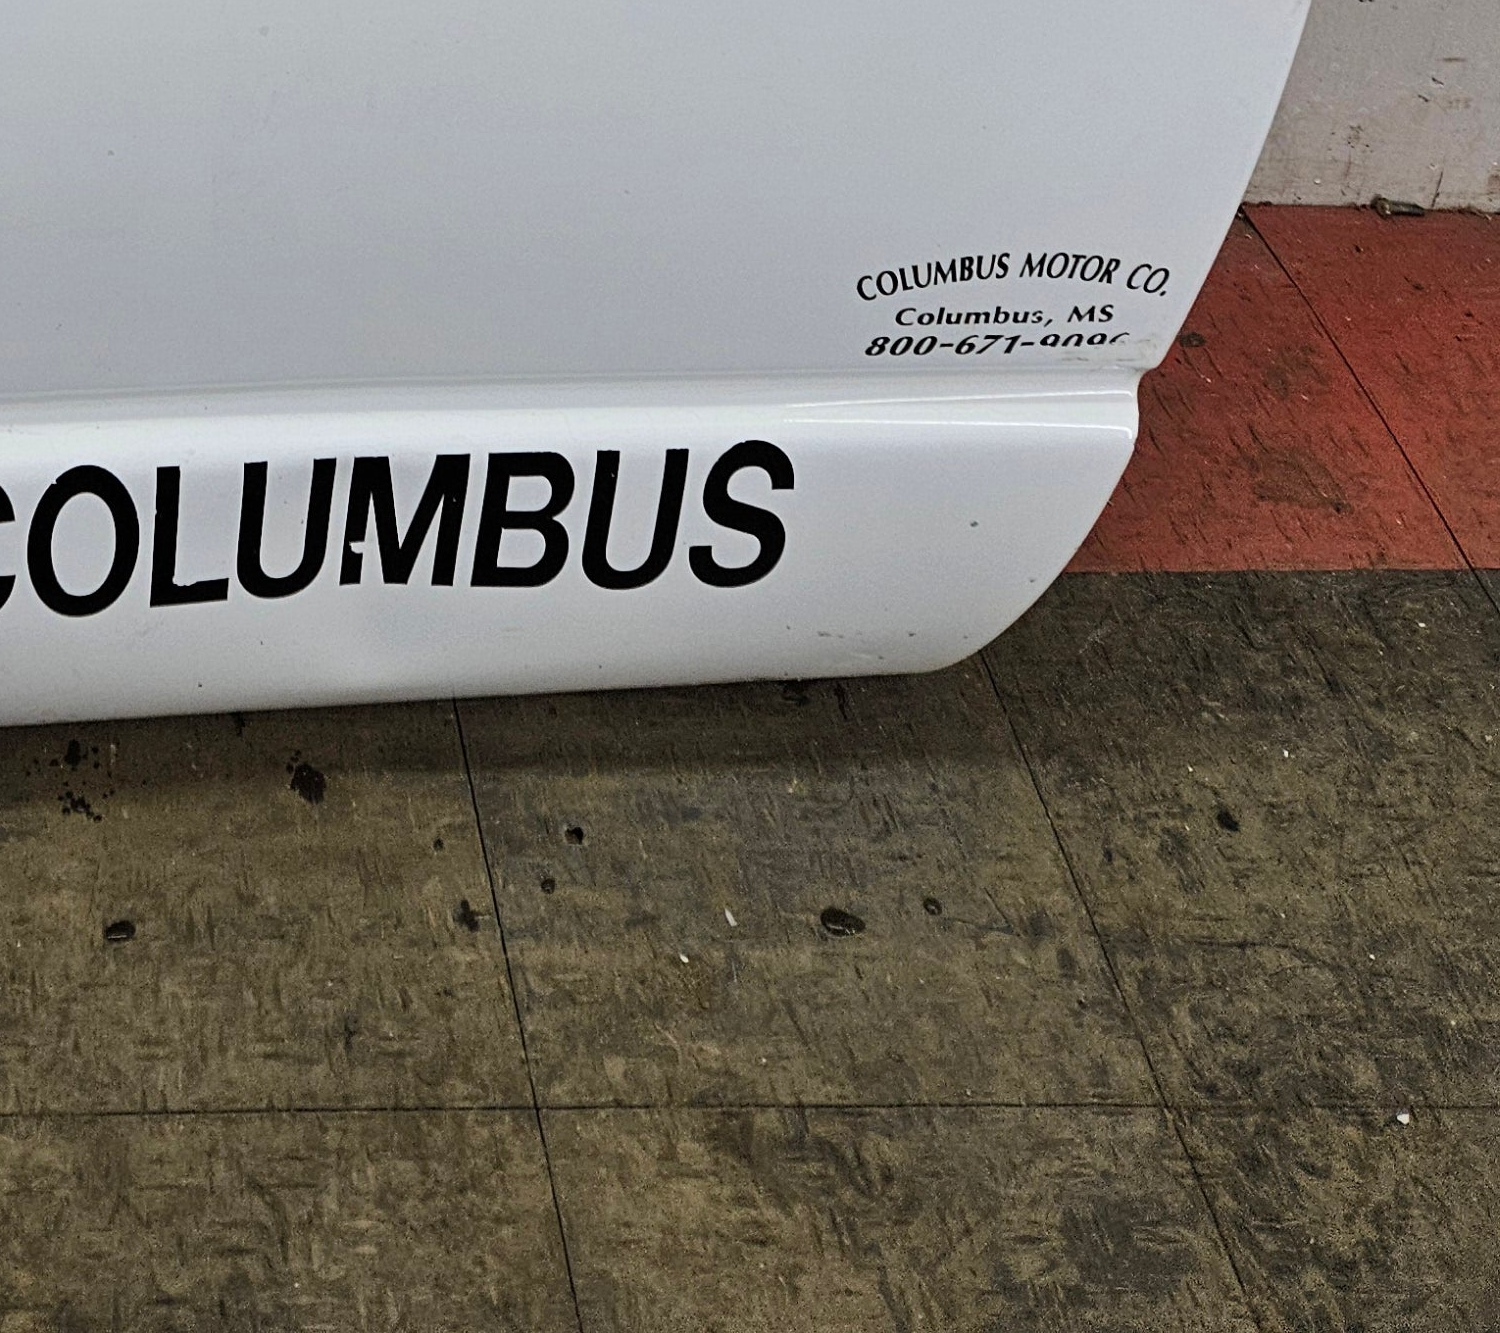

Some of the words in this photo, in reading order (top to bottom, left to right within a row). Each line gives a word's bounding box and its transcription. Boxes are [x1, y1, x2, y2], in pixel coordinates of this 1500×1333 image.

[856, 252, 1011, 301] COLUMBUS
[1018, 252, 1121, 285] MOTOR
[1126, 263, 1170, 297] CO.
[895, 305, 1054, 328] Columbus,
[1067, 304, 1114, 323] MS
